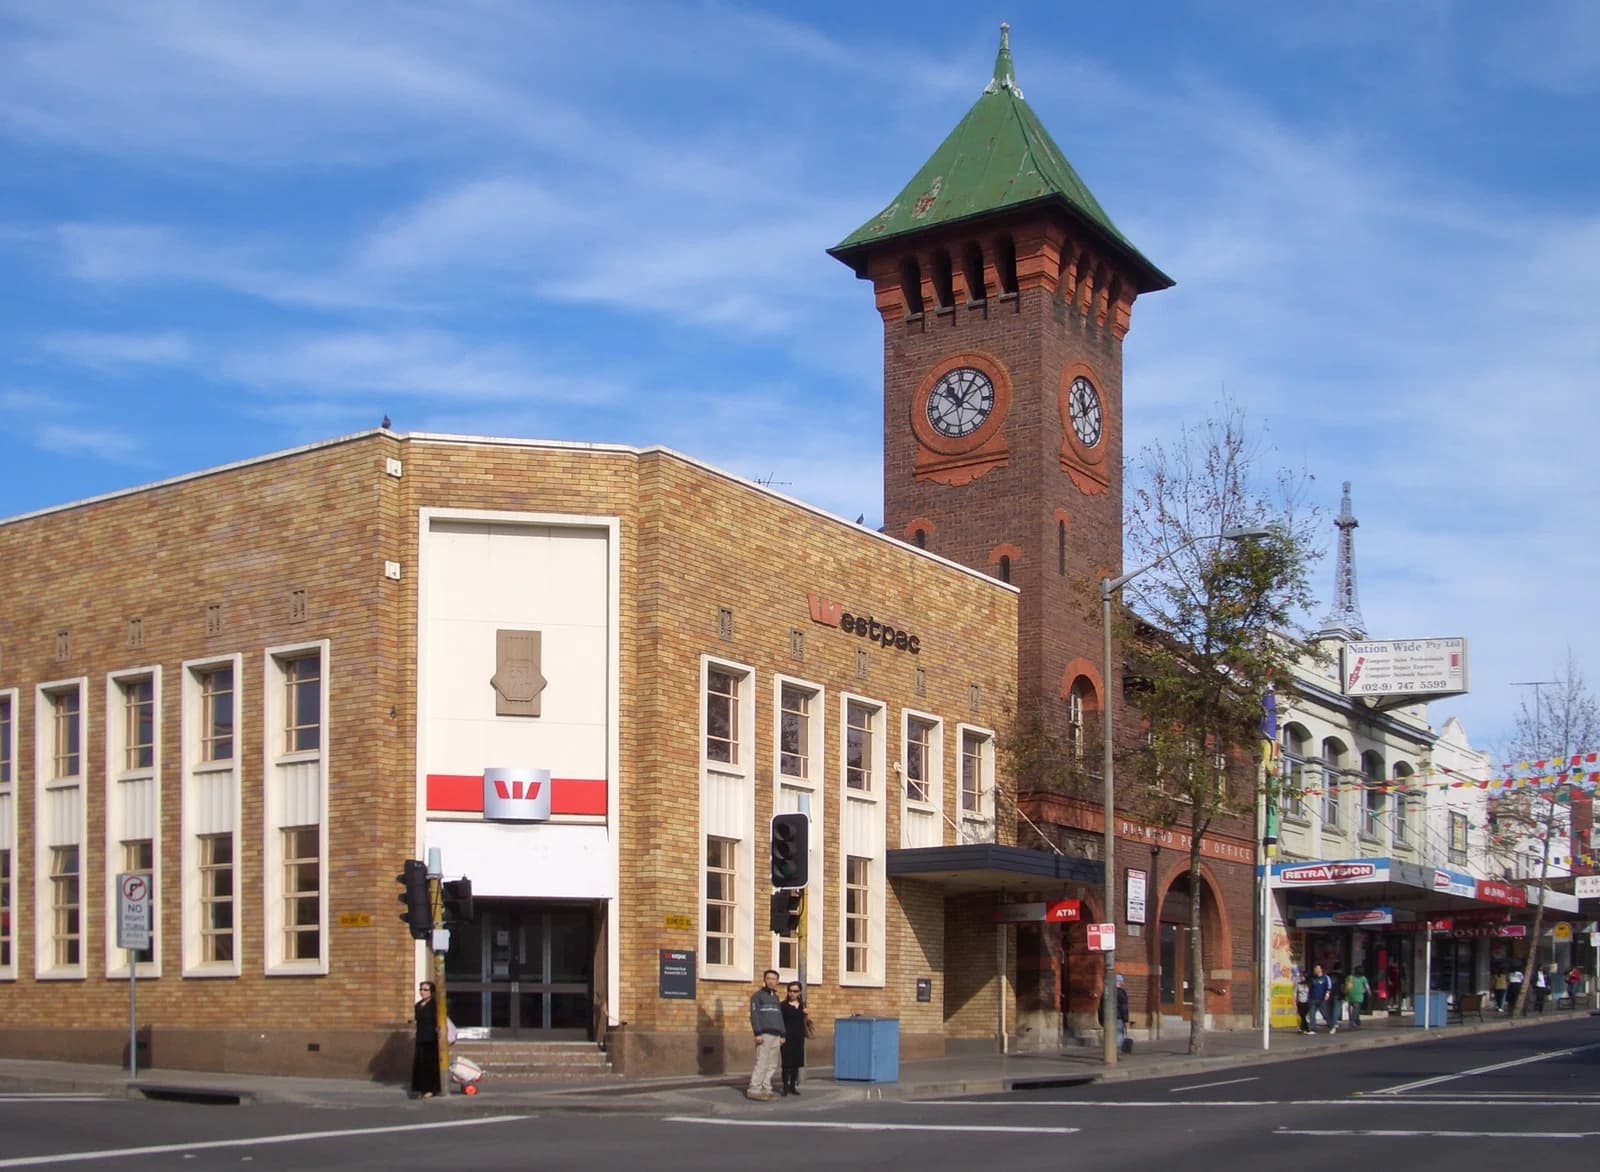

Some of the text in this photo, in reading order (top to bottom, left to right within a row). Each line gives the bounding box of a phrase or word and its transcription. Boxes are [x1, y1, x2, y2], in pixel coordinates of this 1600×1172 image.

[807, 592, 920, 654] Westpac
[1349, 640, 1460, 654] Nation Wide Pty Ltd
[1396, 681, 1414, 690] 747
[1420, 680, 1447, 689] 5599
[1181, 834, 1206, 851] POT
[1214, 842, 1251, 859] OFFICE
[1284, 866, 1371, 880] RETRAVISION
[127, 903, 143, 913] NO
[1056, 908, 1076, 917] ATM
